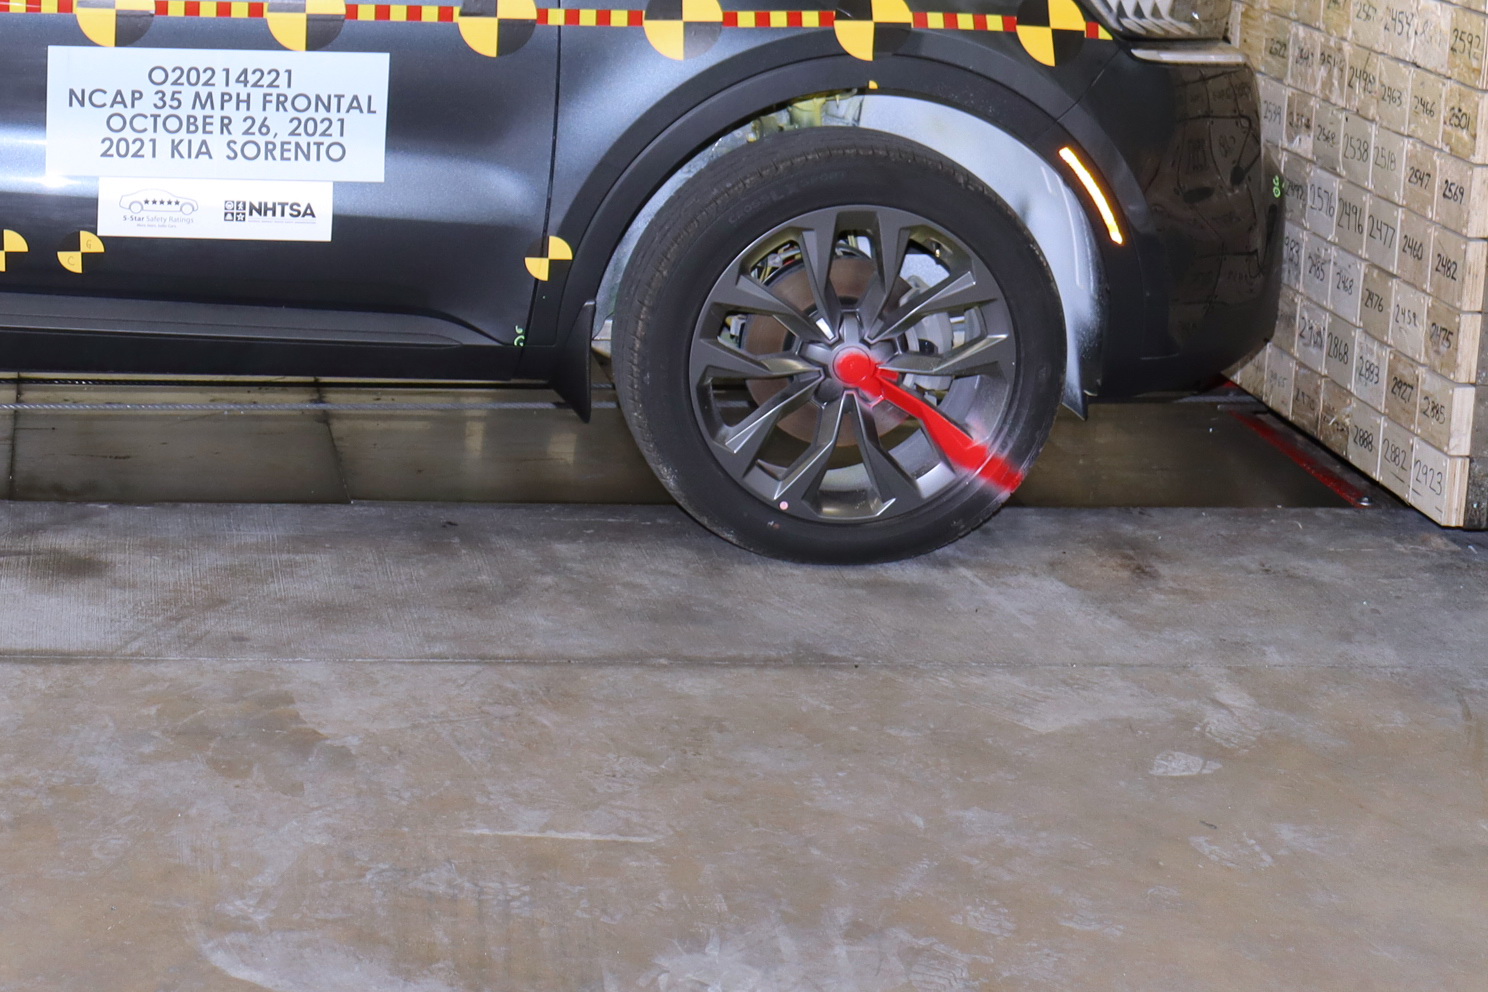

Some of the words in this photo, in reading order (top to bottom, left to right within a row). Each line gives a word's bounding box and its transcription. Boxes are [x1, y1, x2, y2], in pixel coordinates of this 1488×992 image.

[1450, 28, 1481, 60] 2592
[68, 88, 144, 110] NCAP
[152, 90, 183, 110] 35
[191, 91, 252, 112] MPH
[262, 93, 377, 115] FRONTAL
[1381, 84, 1402, 107] 2463
[106, 113, 233, 136] OCTOBER
[242, 116, 279, 139] 26,
[288, 117, 346, 137] 2021
[100, 137, 158, 159] 2021
[170, 138, 213, 160] KIA
[226, 140, 347, 162] SORENTO
[1343, 132, 1369, 163] 2538
[1374, 146, 1396, 172] 2518
[1408, 166, 1431, 190] 2547
[1442, 178, 1465, 205] 2569
[248, 201, 317, 219] NHTSA
[1310, 184, 1335, 218] 2576
[1337, 197, 1363, 235] 2496
[1368, 214, 1396, 248] 2477
[1435, 252, 1458, 281] 2482
[1327, 332, 1349, 365] 2868
[1359, 356, 1380, 384] 2893
[1390, 376, 1415, 404] 2927
[1383, 438, 1407, 472] 2882
[1414, 459, 1443, 496] 2923
